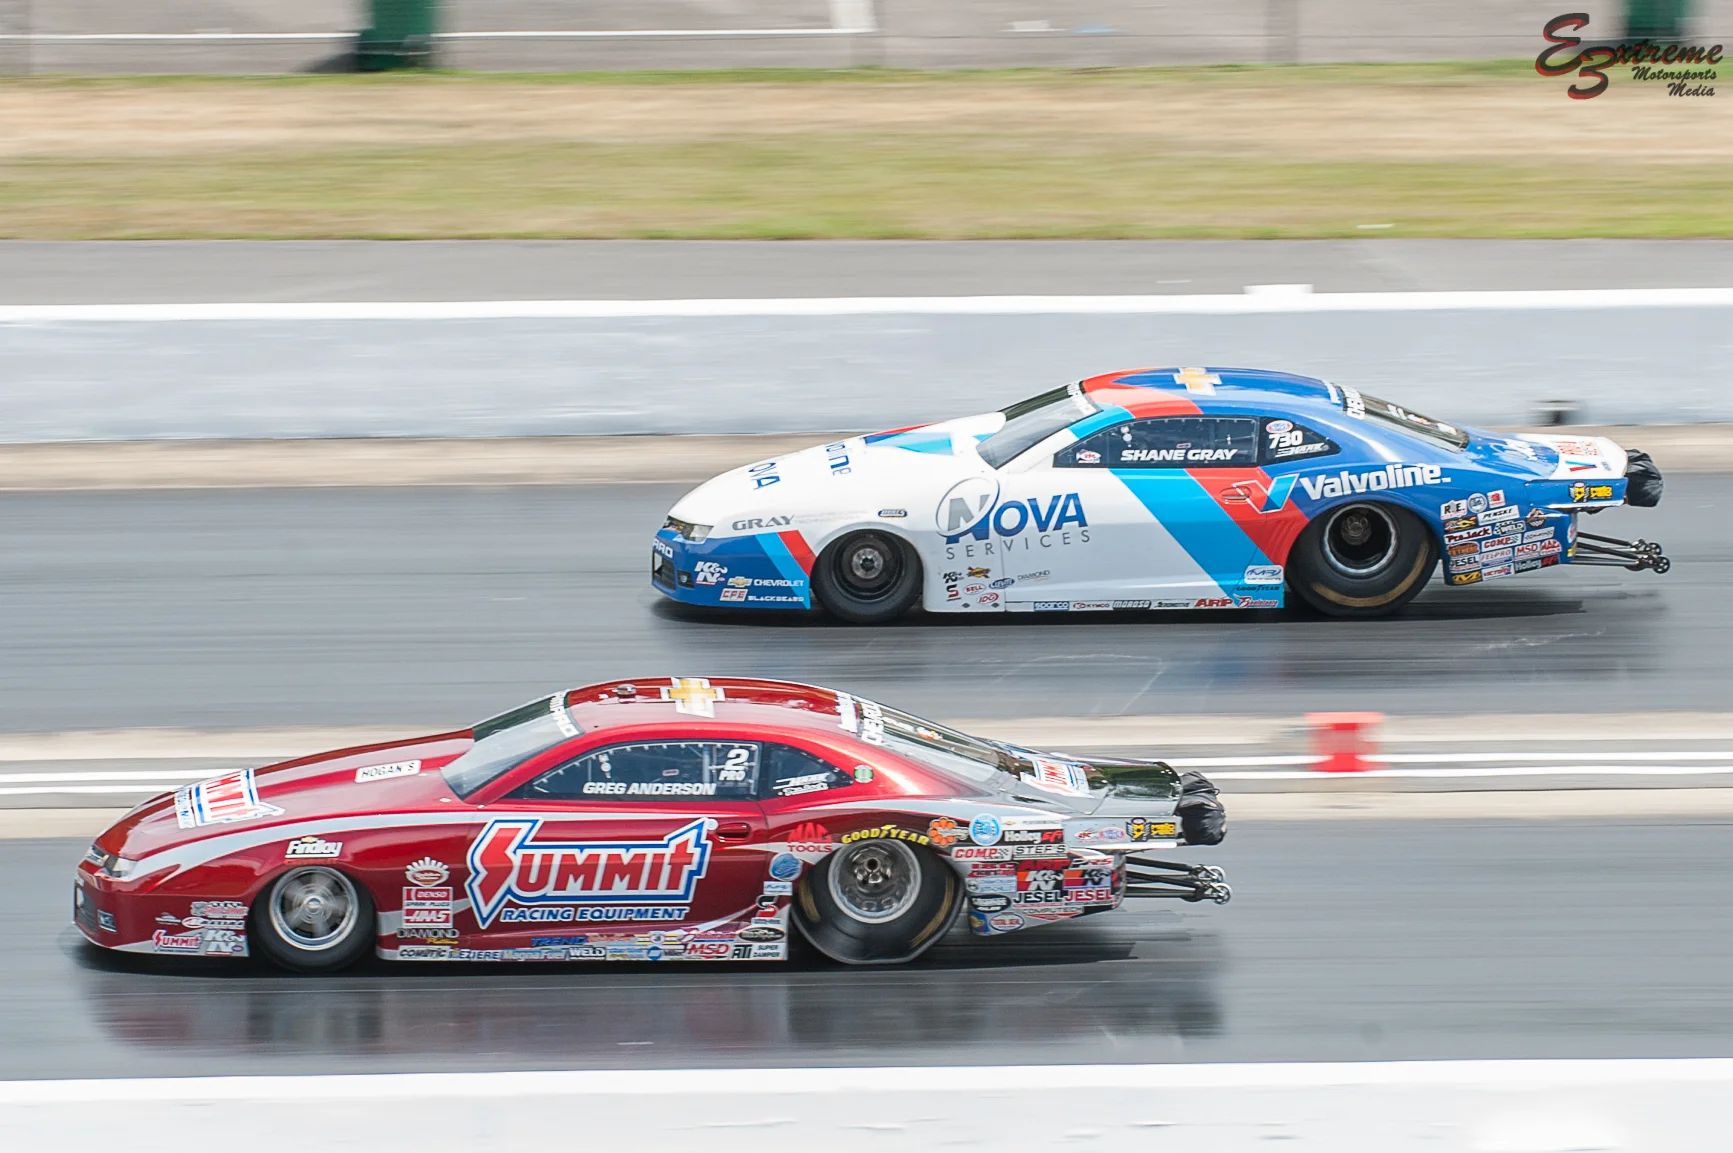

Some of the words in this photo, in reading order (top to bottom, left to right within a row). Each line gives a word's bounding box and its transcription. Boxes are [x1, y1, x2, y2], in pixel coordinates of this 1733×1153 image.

[1269, 430, 1303, 449] 730
[1120, 449, 1185, 461] SHANE
[1187, 449, 1238, 460] GRAY
[748, 462, 781, 491] OVA
[936, 478, 1088, 545] NOVA
[732, 515, 796, 531] GRAY
[946, 529, 1091, 560] SERVICES
[1483, 537, 1511, 549] COMP
[1516, 543, 1538, 554] MSD
[1450, 556, 1479, 567] JESEL
[694, 561, 728, 583] K&N
[1017, 569, 1050, 581] DIAMOND
[753, 579, 804, 587] CHEVROLET
[966, 585, 983, 593] BELL
[1236, 584, 1280, 592] GOODYEAR
[1195, 598, 1233, 608] ARP
[723, 748, 749, 771] 2
[718, 770, 746, 781] PRO
[582, 782, 627, 795] GREG
[628, 783, 717, 796] ANDERSON
[787, 822, 832, 843] MAC
[841, 825, 929, 846] GOODYEAR
[1004, 830, 1042, 844] Holley
[286, 839, 343, 854] Findlay
[788, 845, 832, 853] TOOLS
[955, 848, 998, 858] COMP
[1018, 860, 1071, 870] ARP
[466, 817, 712, 929] SUMMIT
[1025, 870, 1063, 891] K&N
[1013, 892, 1063, 903] JESEL
[1065, 889, 1113, 902] JESEL
[501, 908, 577, 922] RACING
[577, 907, 690, 921] EQUIPMENT
[153, 929, 203, 950] SUMMIT
[397, 929, 459, 938] DIAMOND
[531, 936, 588, 946] TREND
[569, 947, 605, 957] WELD
[688, 944, 729, 954] MSD
[732, 944, 752, 958] ATI
